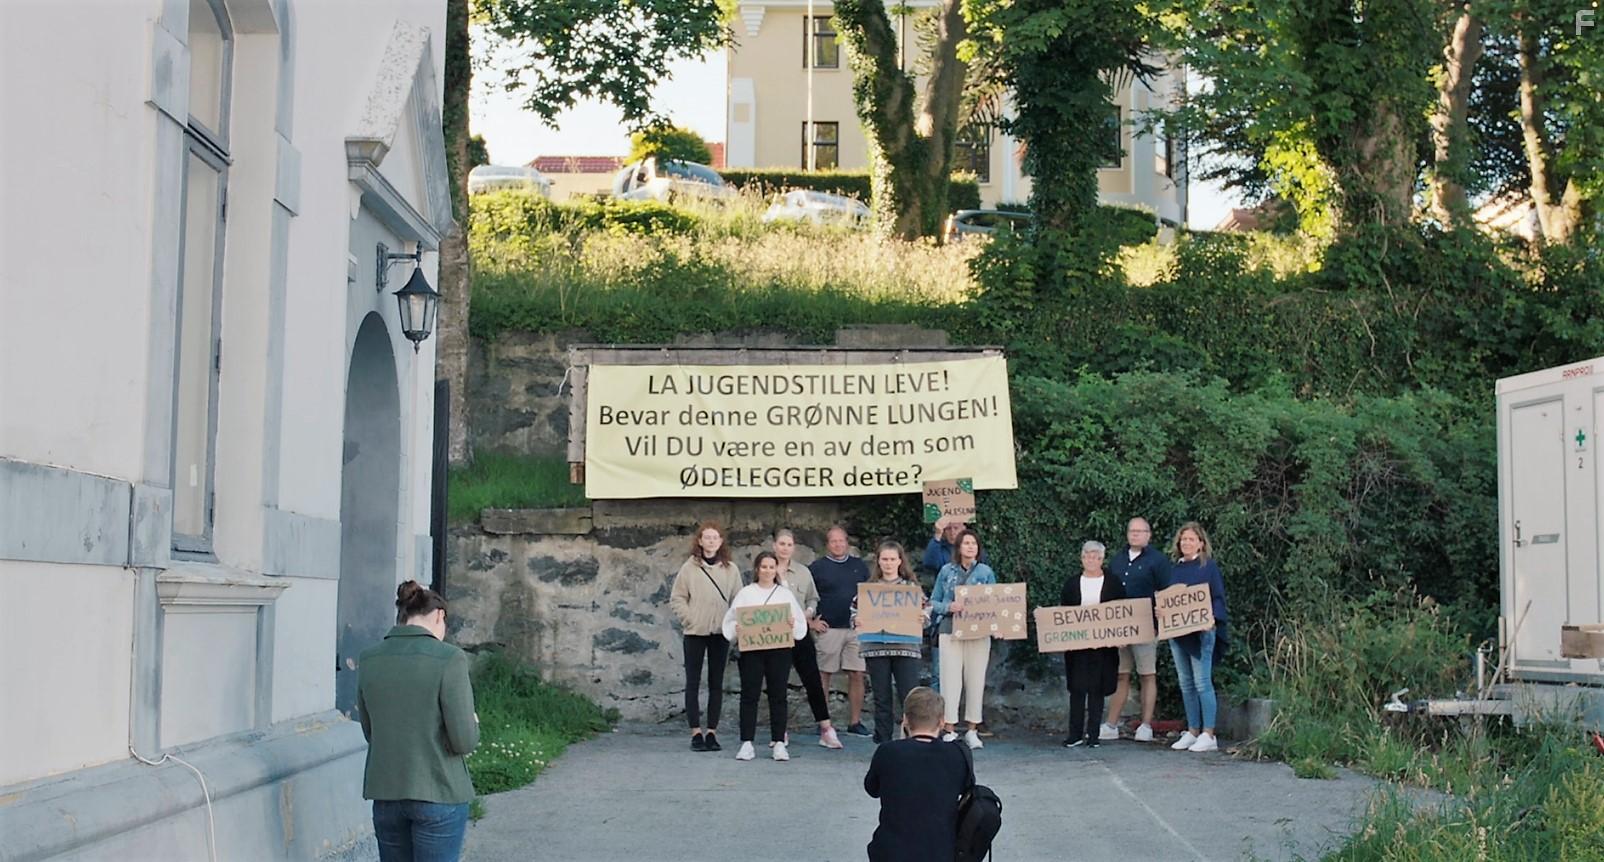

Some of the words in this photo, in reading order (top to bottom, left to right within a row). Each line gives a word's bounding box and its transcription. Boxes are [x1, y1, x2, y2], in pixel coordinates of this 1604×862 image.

[649, 375, 677, 394] LA
[686, 375, 874, 395] JUGENDSTILEN
[886, 370, 948, 394] LEVE!
[600, 406, 670, 425] Bevar
[679, 405, 757, 425] denne
[767, 403, 877, 428] GRØNNE
[889, 393, 997, 424] LUNGEN!
[625, 435, 656, 456] Vil
[668, 437, 702, 456] DU
[713, 442, 774, 457] være
[785, 442, 813, 456] en
[824, 442, 851, 456] av
[861, 435, 914, 455] dem
[924, 435, 974, 453] som
[1578, 457, 1584, 469] 2
[680, 465, 833, 489] ØDELEGGER
[843, 464, 922, 487] dette?
[867, 589, 919, 608] VERN
[1161, 590, 1206, 609] JUGEND
[1053, 608, 1101, 626] BEVAR
[1105, 606, 1133, 621] DEN
[1162, 608, 1209, 629] LEVER
[1044, 631, 1090, 644] GRØNNE
[1093, 626, 1139, 641] LUNGEN
